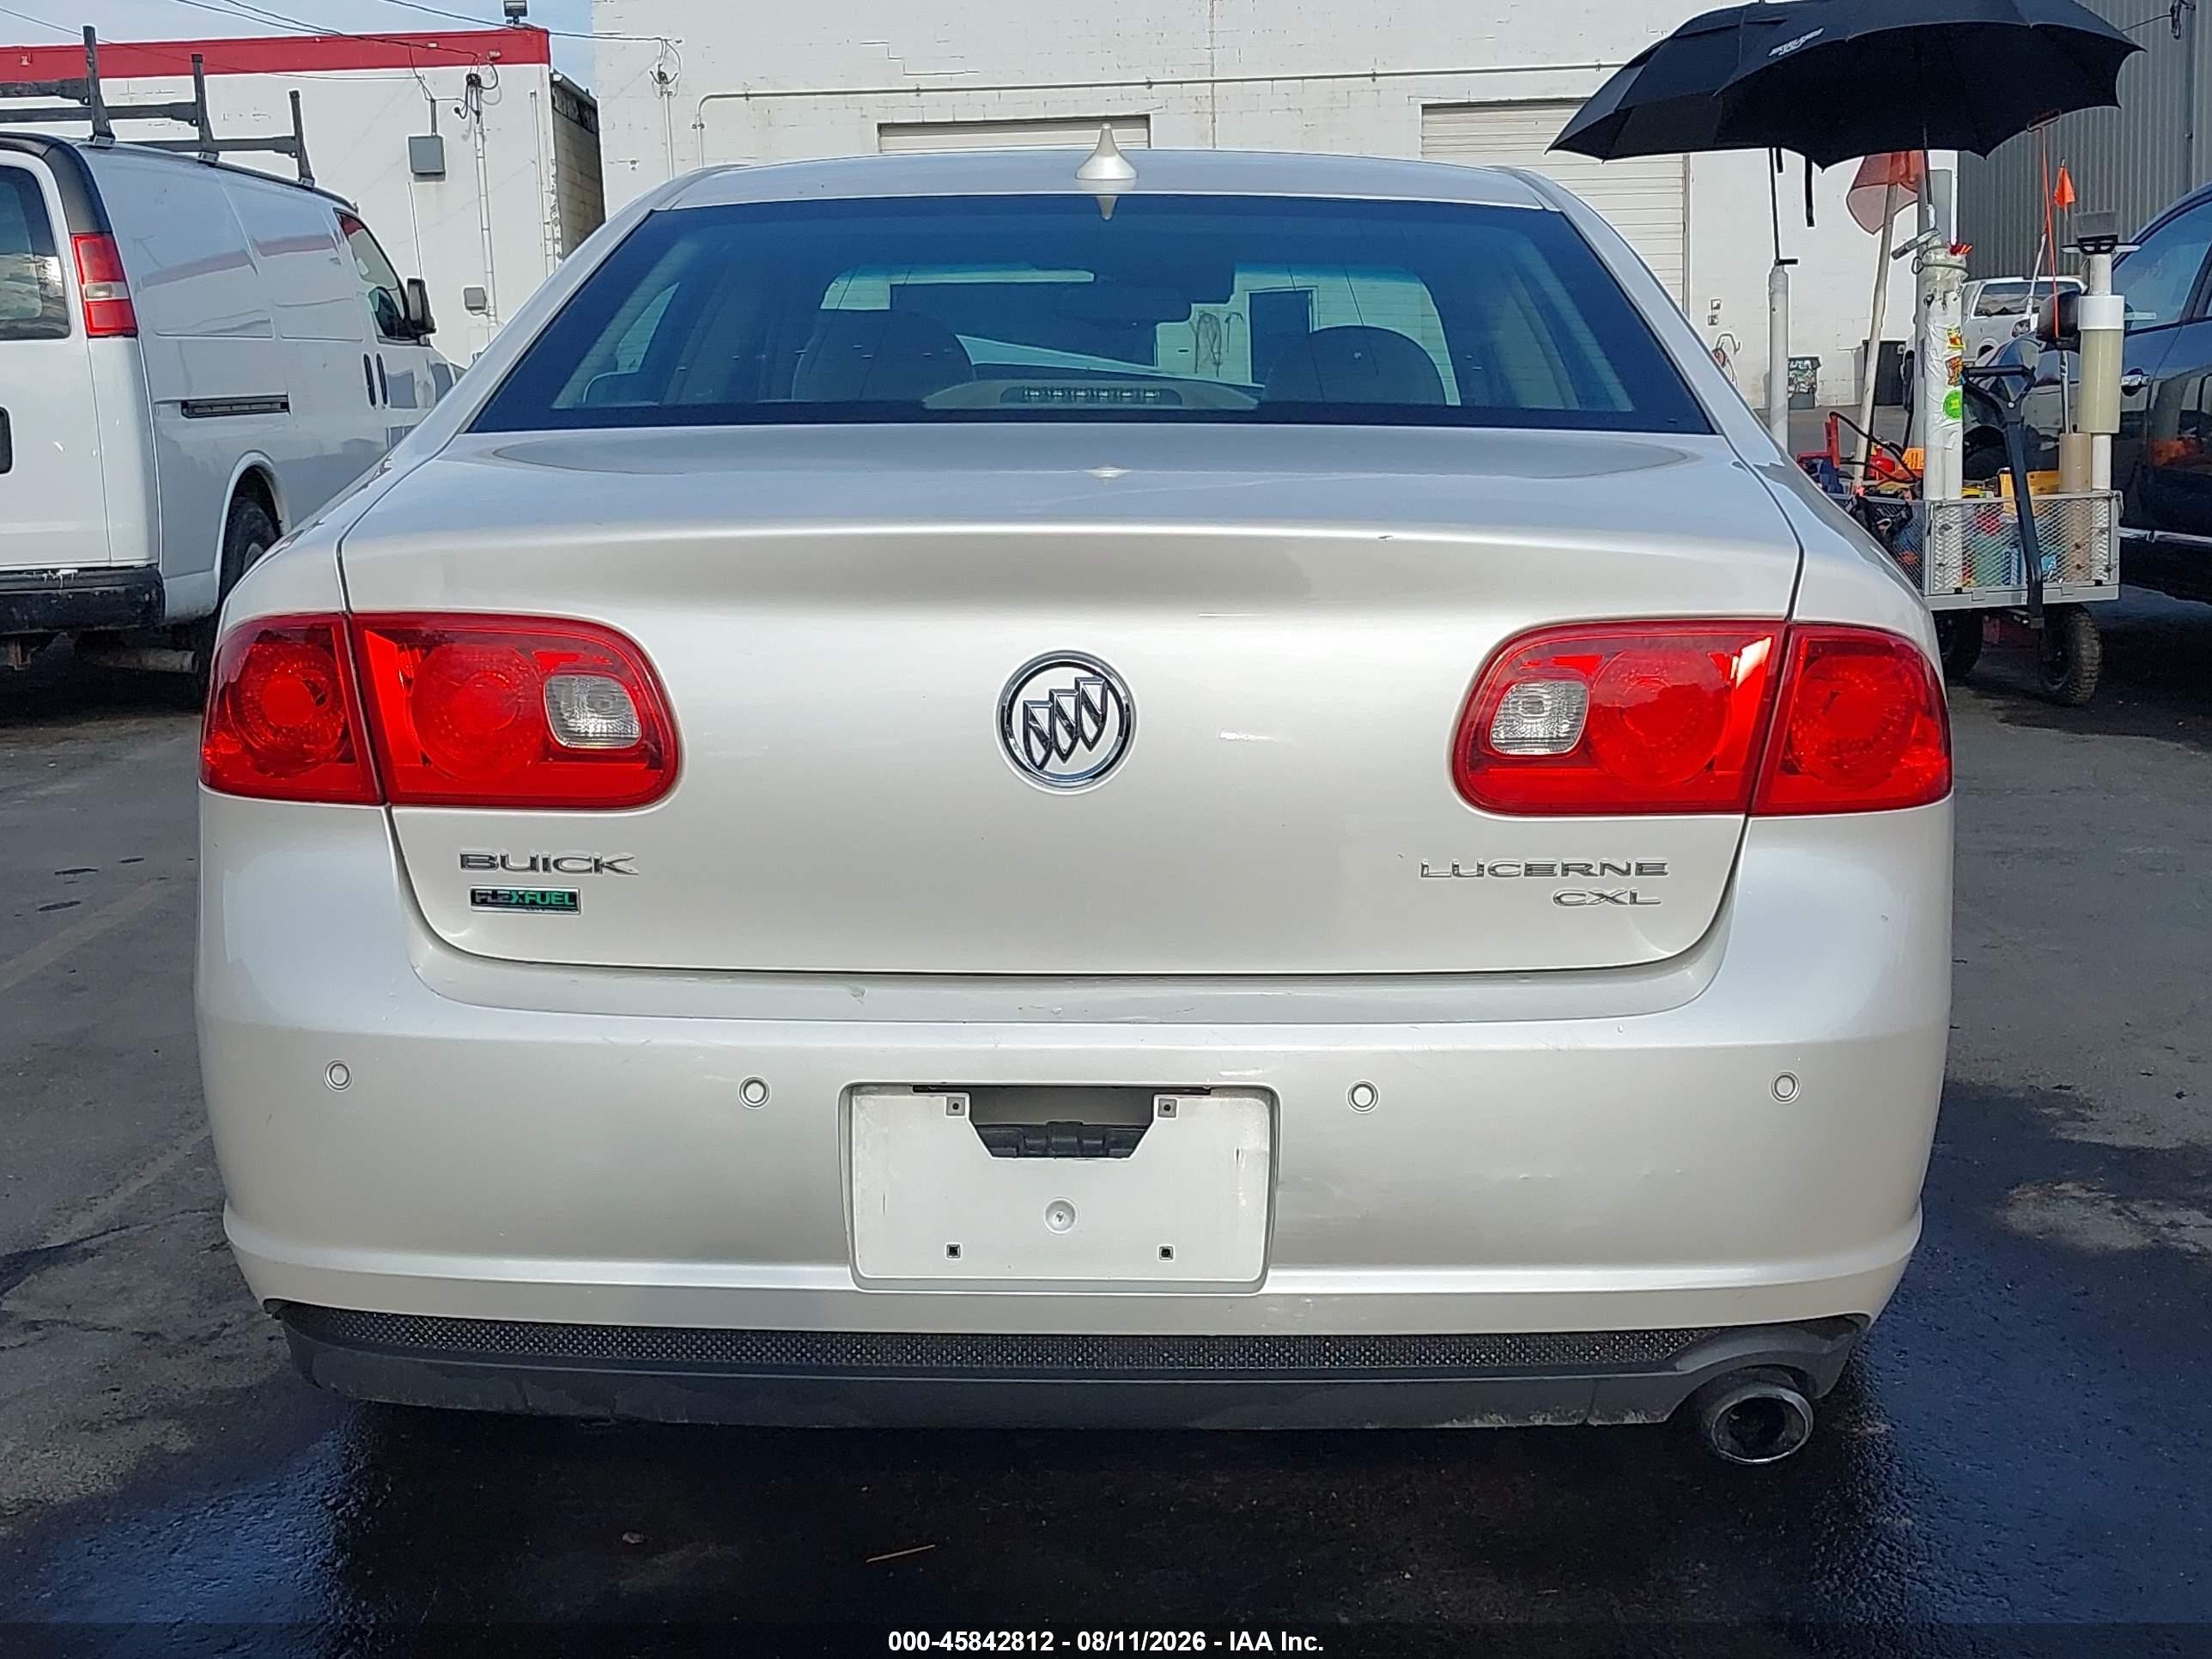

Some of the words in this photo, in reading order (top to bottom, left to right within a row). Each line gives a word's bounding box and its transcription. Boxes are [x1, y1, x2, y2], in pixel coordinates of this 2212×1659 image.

[459, 852, 639, 875] BUICK
[1420, 860, 1668, 878] LUCERNE
[474, 890, 575, 906] FLEXFUEL
[1553, 888, 1662, 907] CXL
